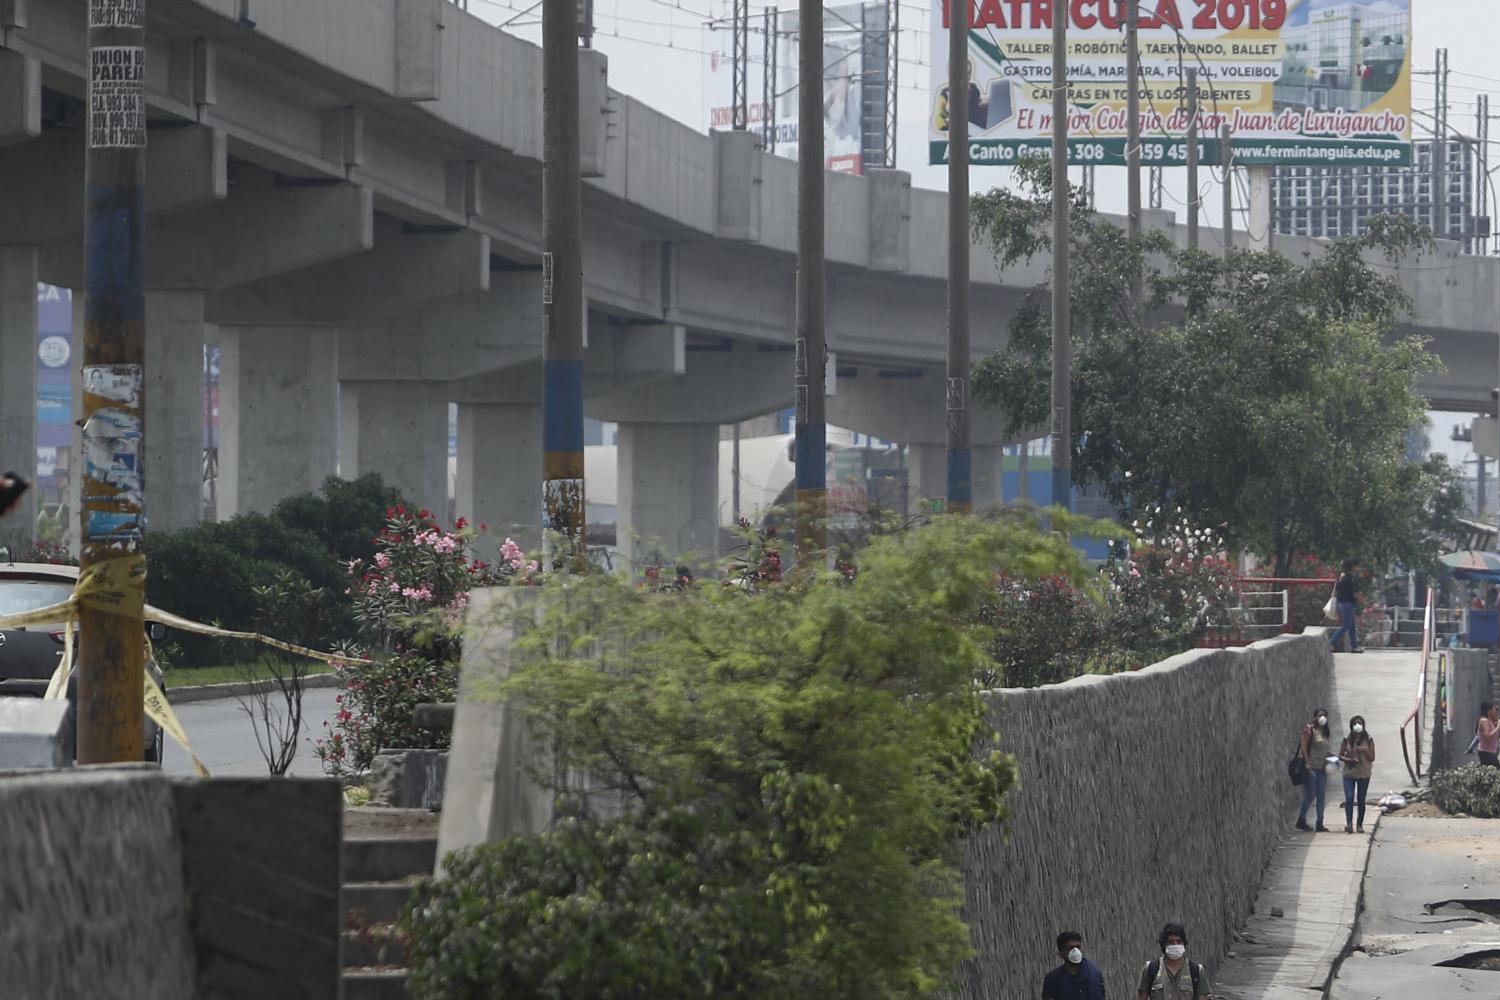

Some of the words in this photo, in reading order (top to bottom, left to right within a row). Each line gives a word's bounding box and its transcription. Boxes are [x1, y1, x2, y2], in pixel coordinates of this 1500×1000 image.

[941, 0, 1183, 29] ATRCUA
[1192, 0, 1286, 30] 2019
[1006, 43, 1072, 54] TALLER:
[1075, 40, 1142, 56] ROBÓTIC,
[1146, 43, 1226, 56] TAEKWONDO,
[1232, 44, 1277, 54] BALLET
[92, 50, 132, 65] UNION
[92, 66, 144, 80] PAREJA
[1004, 64, 1095, 77] GASTROOMÍA,
[1100, 67, 1163, 77] MARIERA,
[1167, 65, 1217, 78] FÚTOL,
[1221, 67, 1279, 77] VOLEIBOL
[1032, 87, 1091, 100] CÁRAS
[1094, 90, 1110, 100] EN
[1114, 90, 1153, 100] TOOS
[1157, 90, 1180, 100] LOS
[1018, 108, 1033, 130] El
[1038, 111, 1090, 134] mjor
[1097, 108, 1165, 135] Colgio
[1230, 109, 1273, 135] Juan
[1278, 109, 1298, 131] de
[1305, 110, 1405, 136] Lurigancho
[970, 145, 1012, 160] Canto
[1018, 145, 1071, 160] Grane
[1075, 145, 1104, 160] 308
[1168, 144, 1204, 160] 451
[1231, 145, 1400, 161] www.fermintanguis.edu.pe
